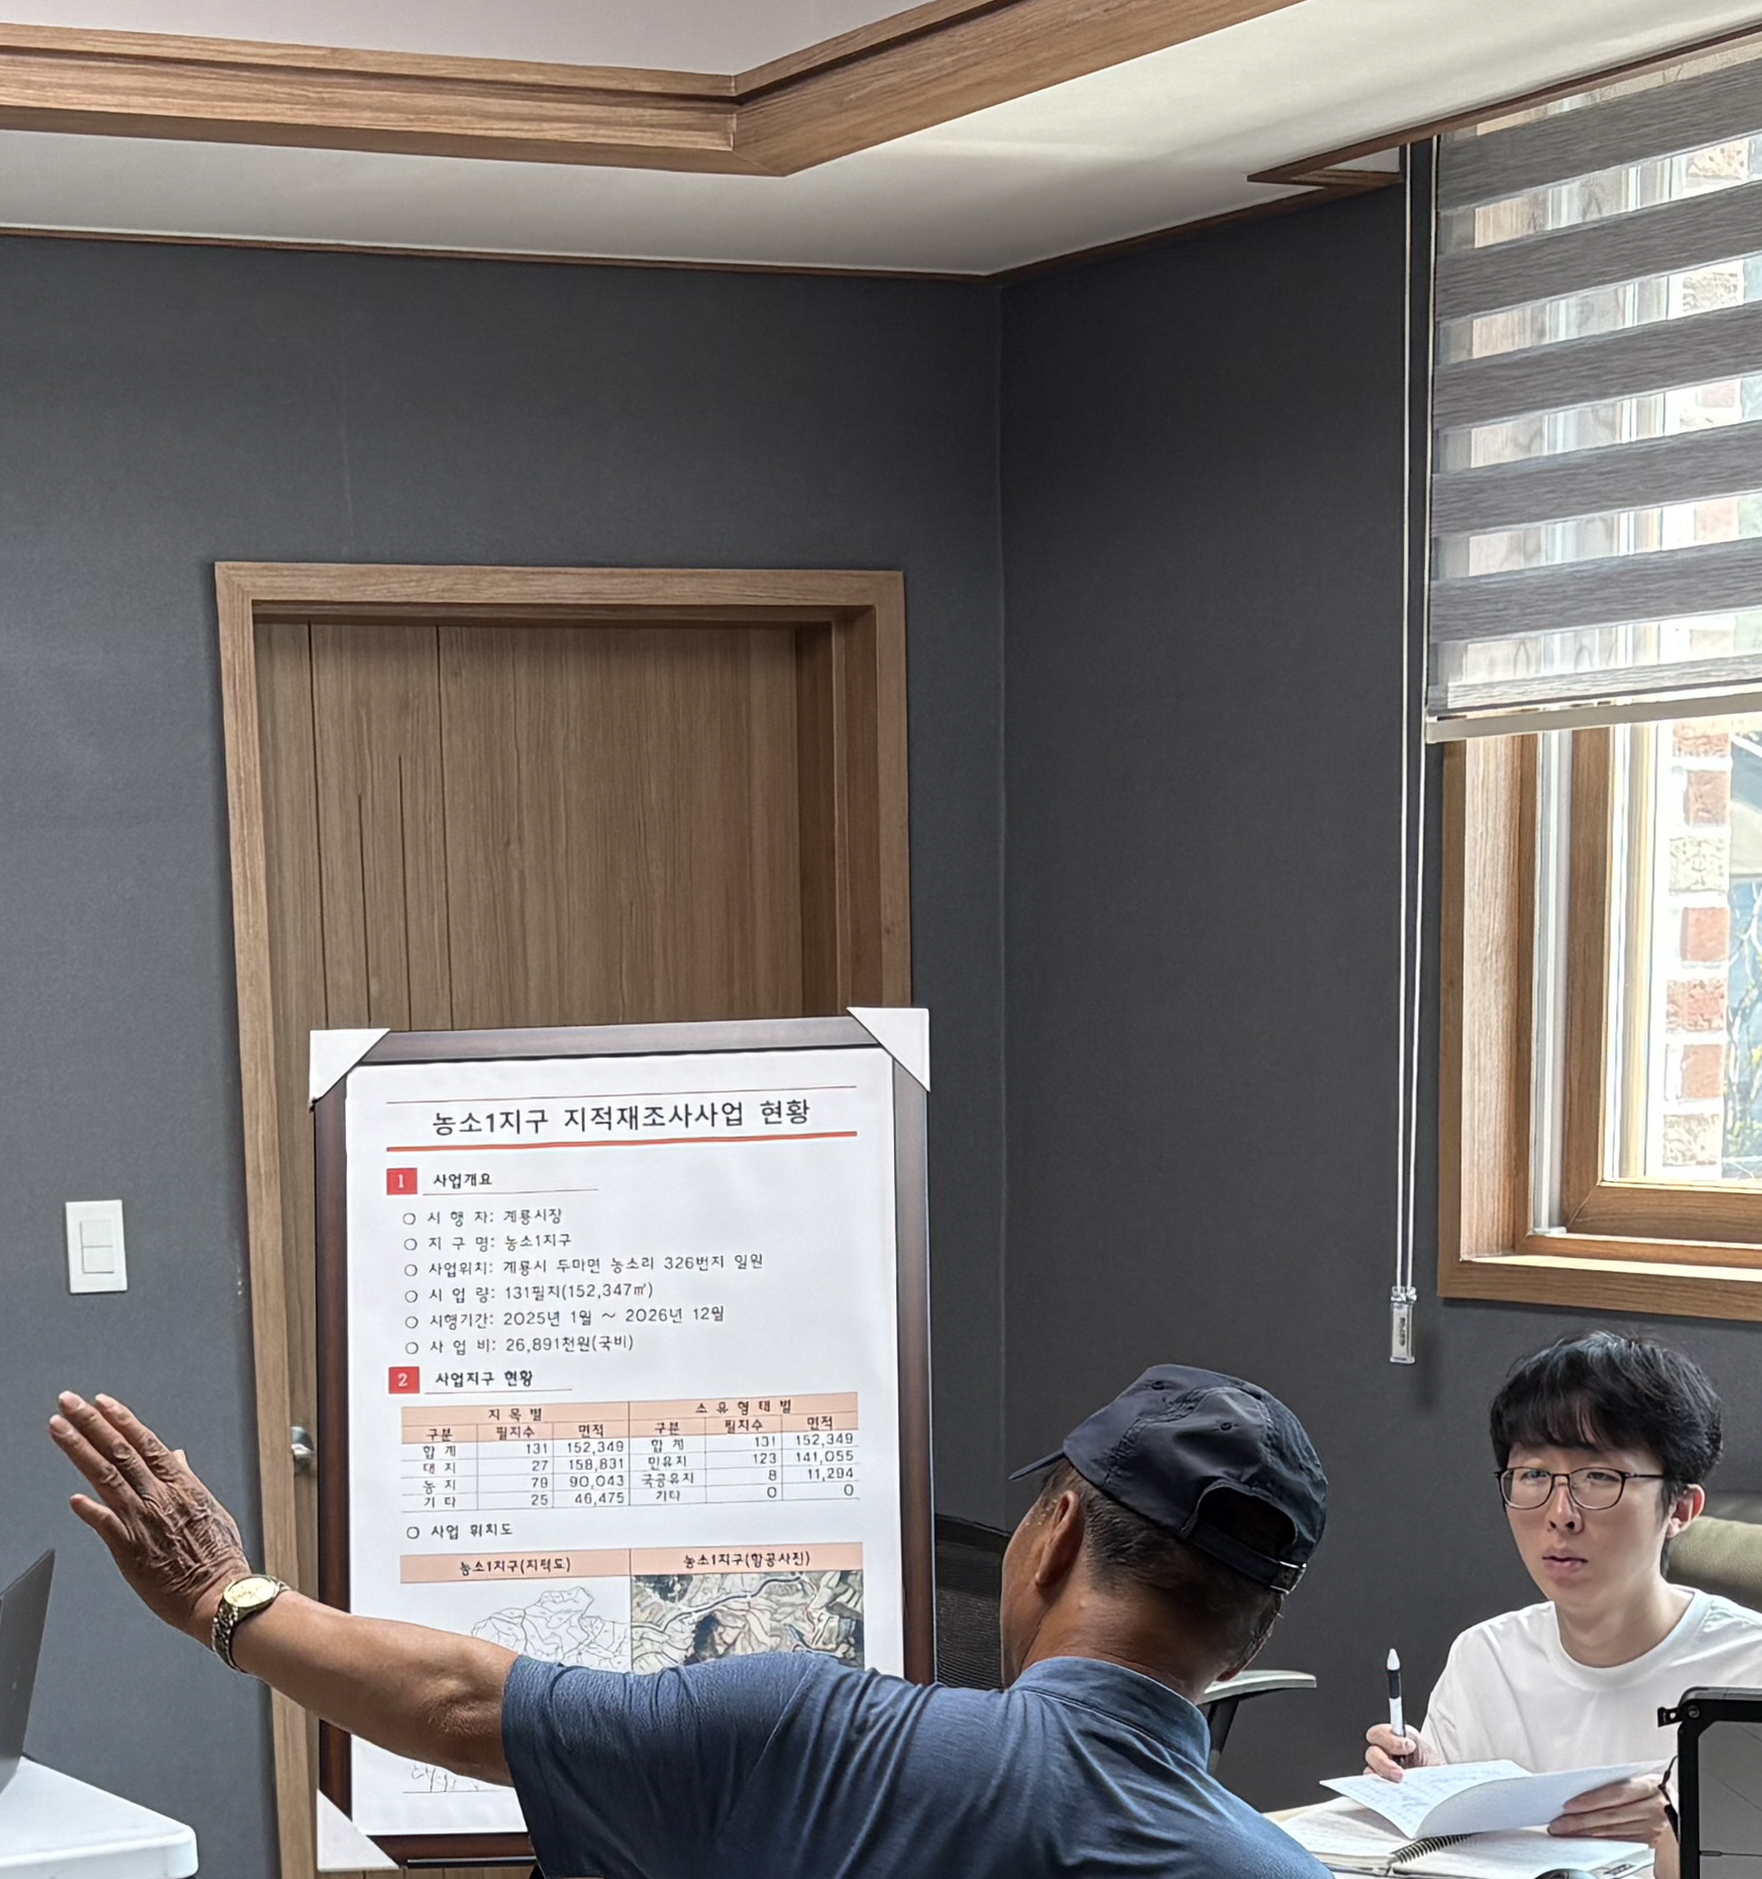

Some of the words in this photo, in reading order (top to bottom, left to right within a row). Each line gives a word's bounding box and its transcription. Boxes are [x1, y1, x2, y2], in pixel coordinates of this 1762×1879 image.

[432, 1112, 549, 1136] 농소1지구
[564, 1102, 744, 1132] 지적재조사사업
[760, 1099, 810, 1126] 현황
[398, 1174, 405, 1188] 1
[433, 1173, 493, 1188] 사업개요
[503, 1208, 562, 1225] 계룡시장
[505, 1233, 571, 1251] 농소1지구
[503, 1259, 547, 1276] 계룡시
[556, 1257, 600, 1275] 두마면
[610, 1257, 654, 1274] 농소리
[664, 1255, 724, 1271] 326번지
[503, 1312, 560, 1327] 2025년
[570, 1310, 592, 1326] 1월
[625, 1308, 682, 1324] 2026년
[693, 1306, 724, 1322] 12월
[397, 1373, 408, 1387] 2
[435, 1372, 495, 1388] 사업지구
[504, 1370, 533, 1387] 현황
[578, 1423, 604, 1439] 면적
[807, 1416, 833, 1431] 면적
[426, 1428, 453, 1442] 구분
[496, 1426, 535, 1440] 필지수
[796, 1433, 853, 1447] 152,349
[525, 1444, 548, 1455] 131
[753, 1453, 777, 1465] 123
[797, 1450, 854, 1465] 141,055
[531, 1460, 548, 1472] 27
[569, 1476, 624, 1490] 90,043
[844, 1484, 854, 1496] 0
[531, 1494, 548, 1506] 25
[767, 1487, 777, 1498] 0
[430, 1524, 460, 1540] 사업
